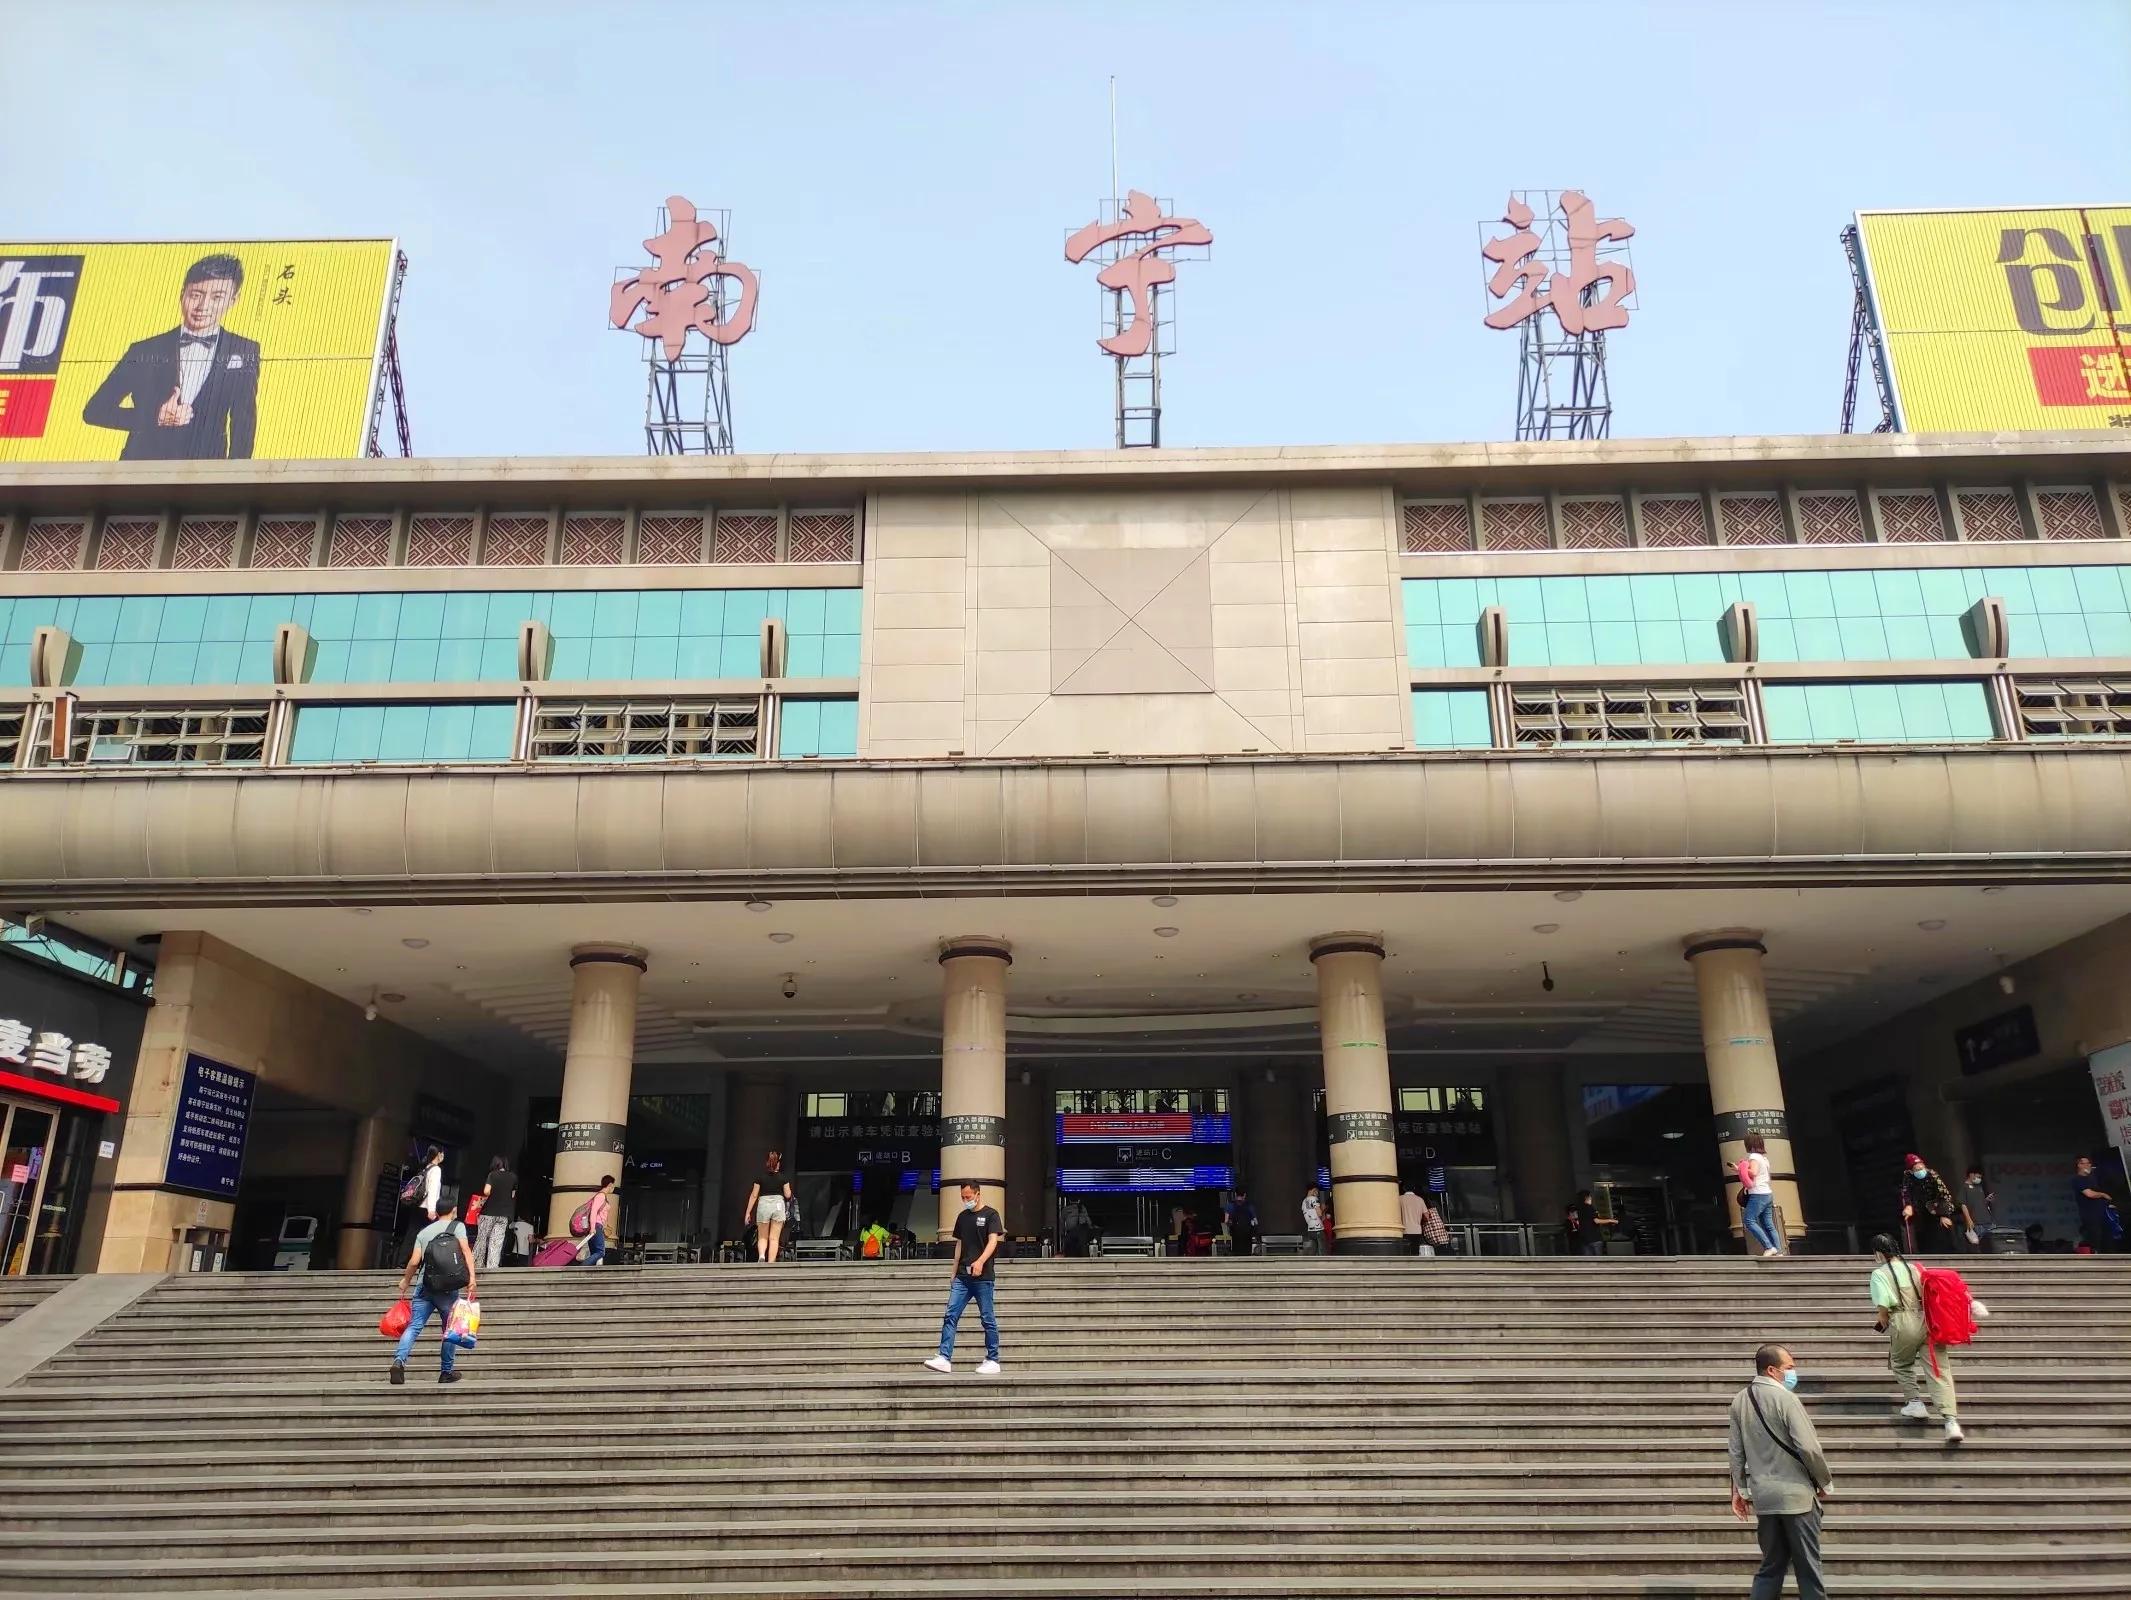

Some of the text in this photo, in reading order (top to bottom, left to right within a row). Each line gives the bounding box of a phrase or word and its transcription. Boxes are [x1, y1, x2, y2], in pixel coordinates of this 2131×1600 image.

[0, 1018, 113, 1084] 麦当劳
[901, 1151, 911, 1163] B
[1161, 1147, 1172, 1160] C
[1425, 1146, 1436, 1159] D
[624, 1155, 635, 1167] A
